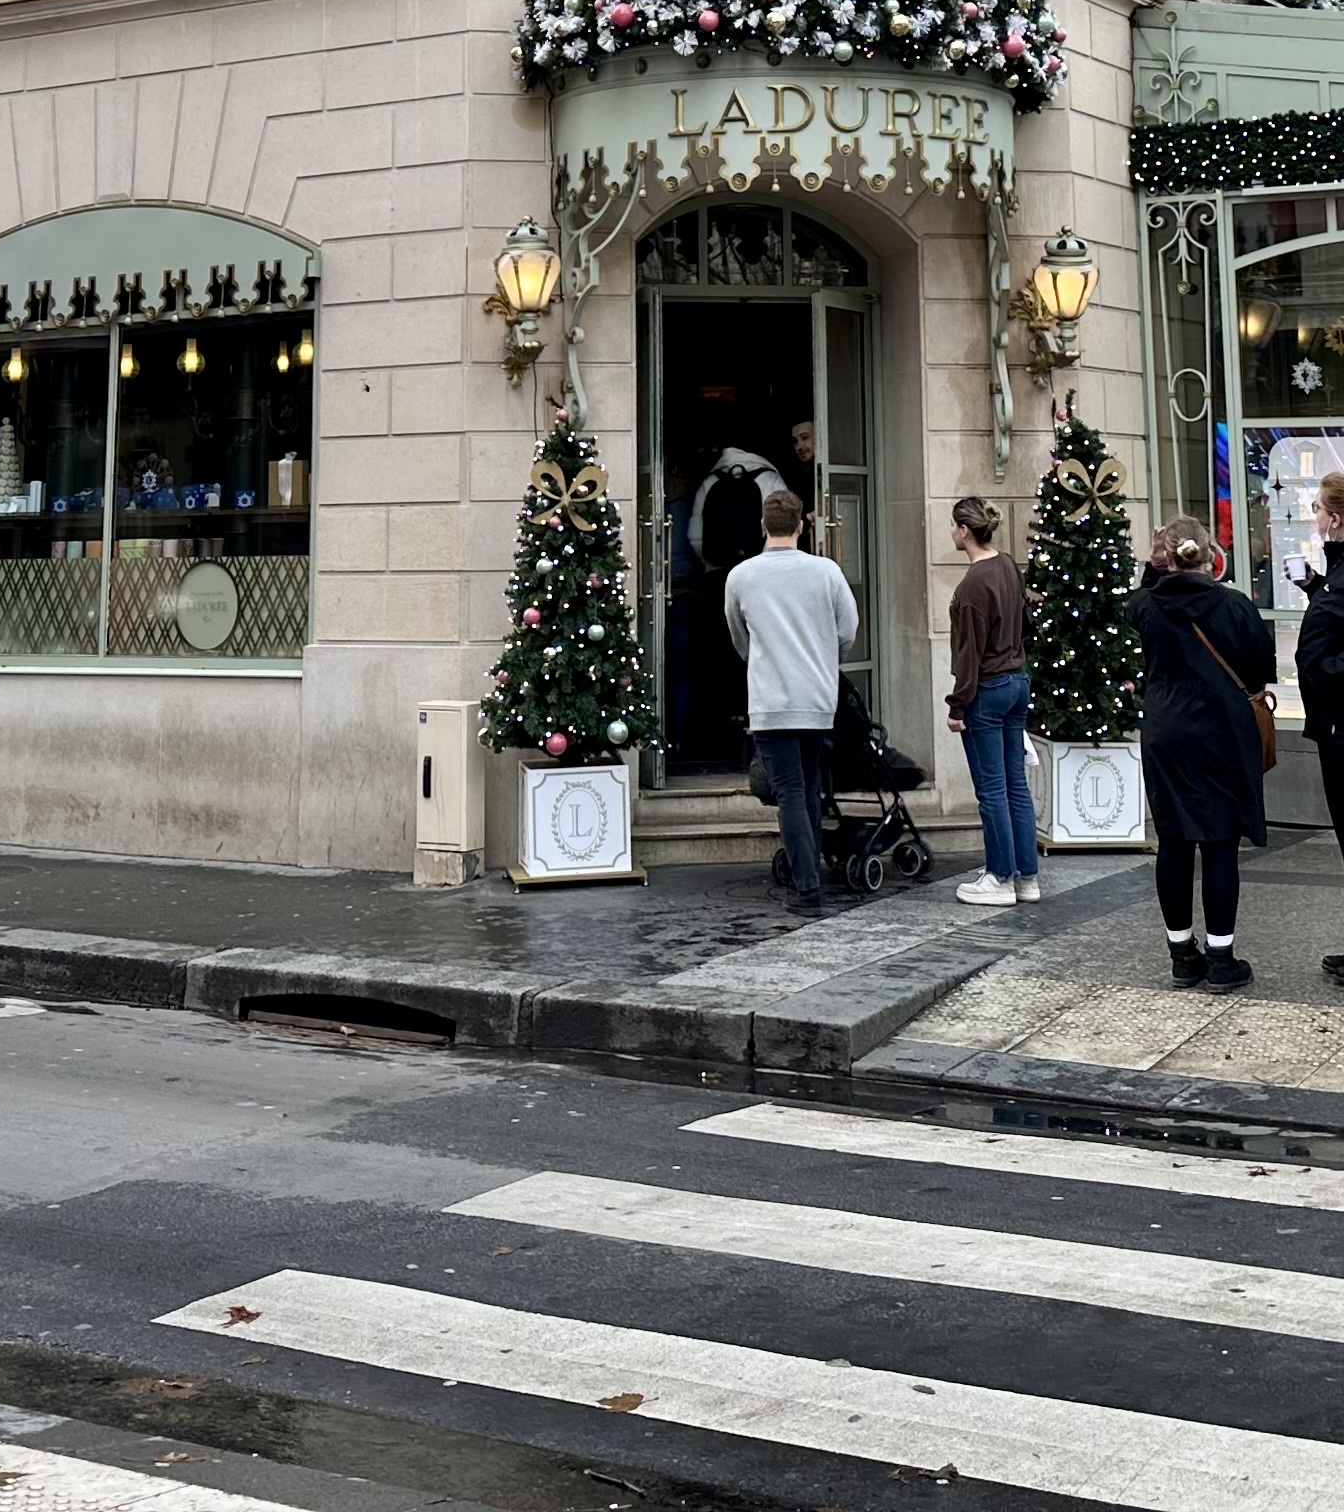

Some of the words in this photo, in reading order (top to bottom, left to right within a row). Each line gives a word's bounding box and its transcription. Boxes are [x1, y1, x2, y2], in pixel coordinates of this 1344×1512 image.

[668, 84, 989, 145] LADUREE
[1089, 776, 1111, 808] L
[568, 803, 593, 837] L
